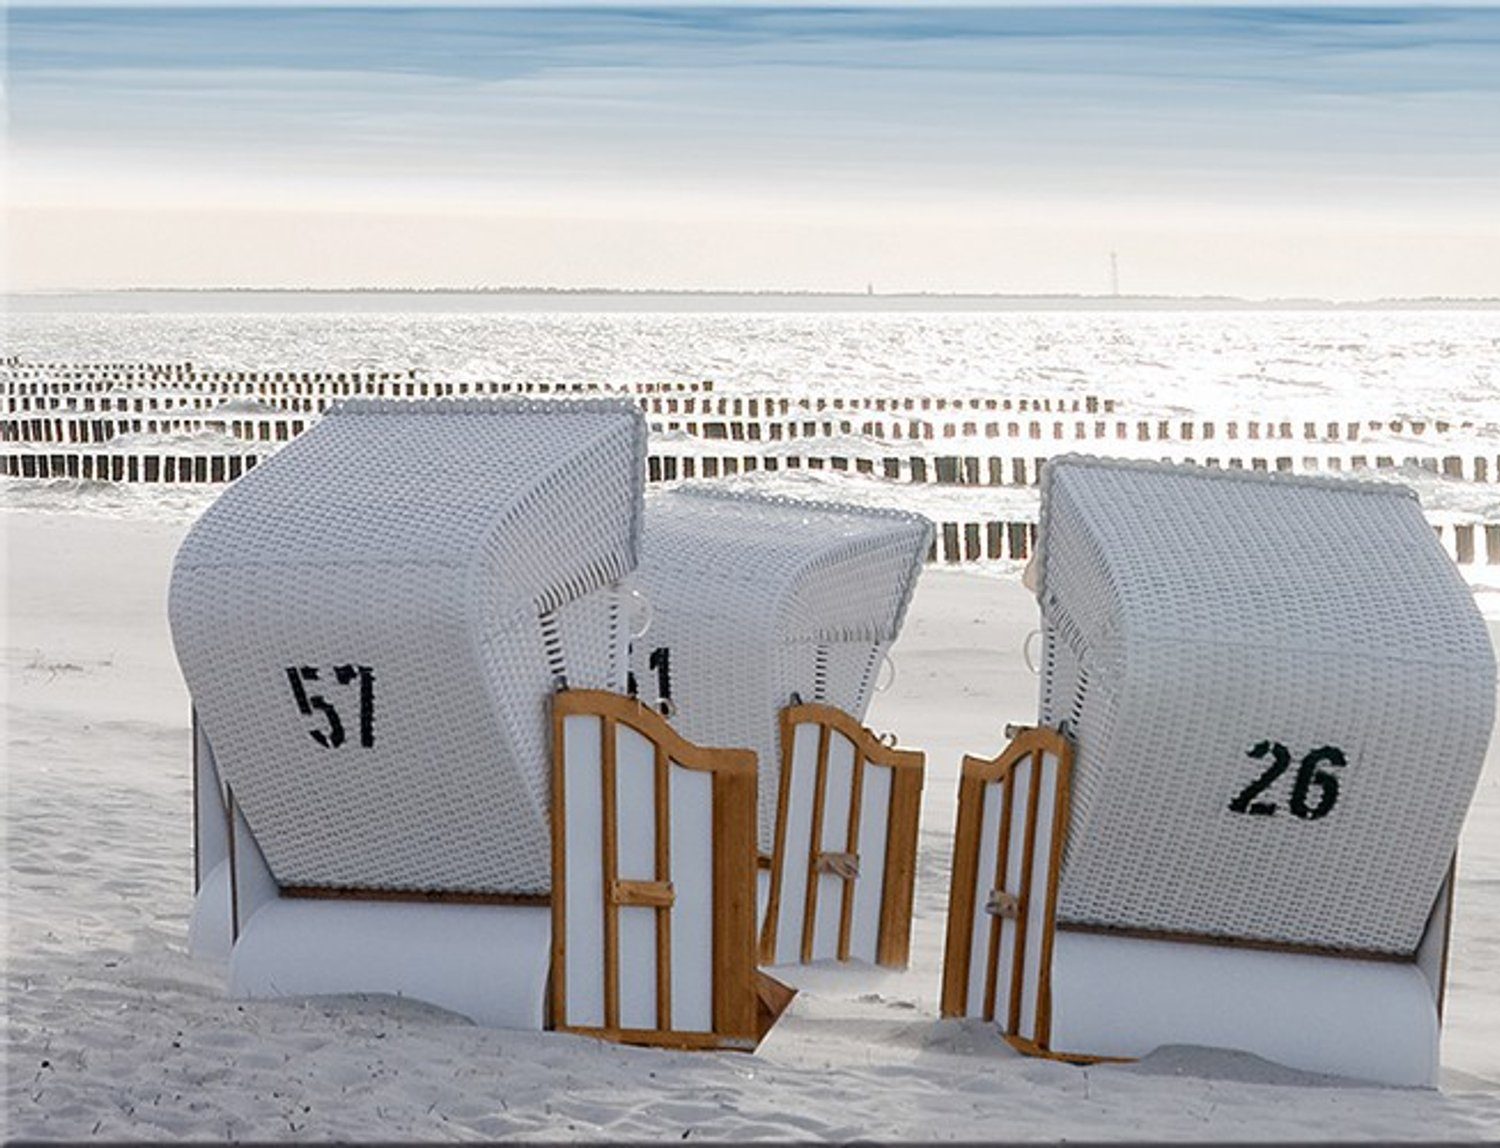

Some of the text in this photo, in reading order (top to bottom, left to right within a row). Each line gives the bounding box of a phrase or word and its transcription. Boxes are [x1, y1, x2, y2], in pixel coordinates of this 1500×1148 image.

[285, 663, 376, 749] 57
[627, 641, 672, 714] 1
[1228, 739, 1348, 820] 26
